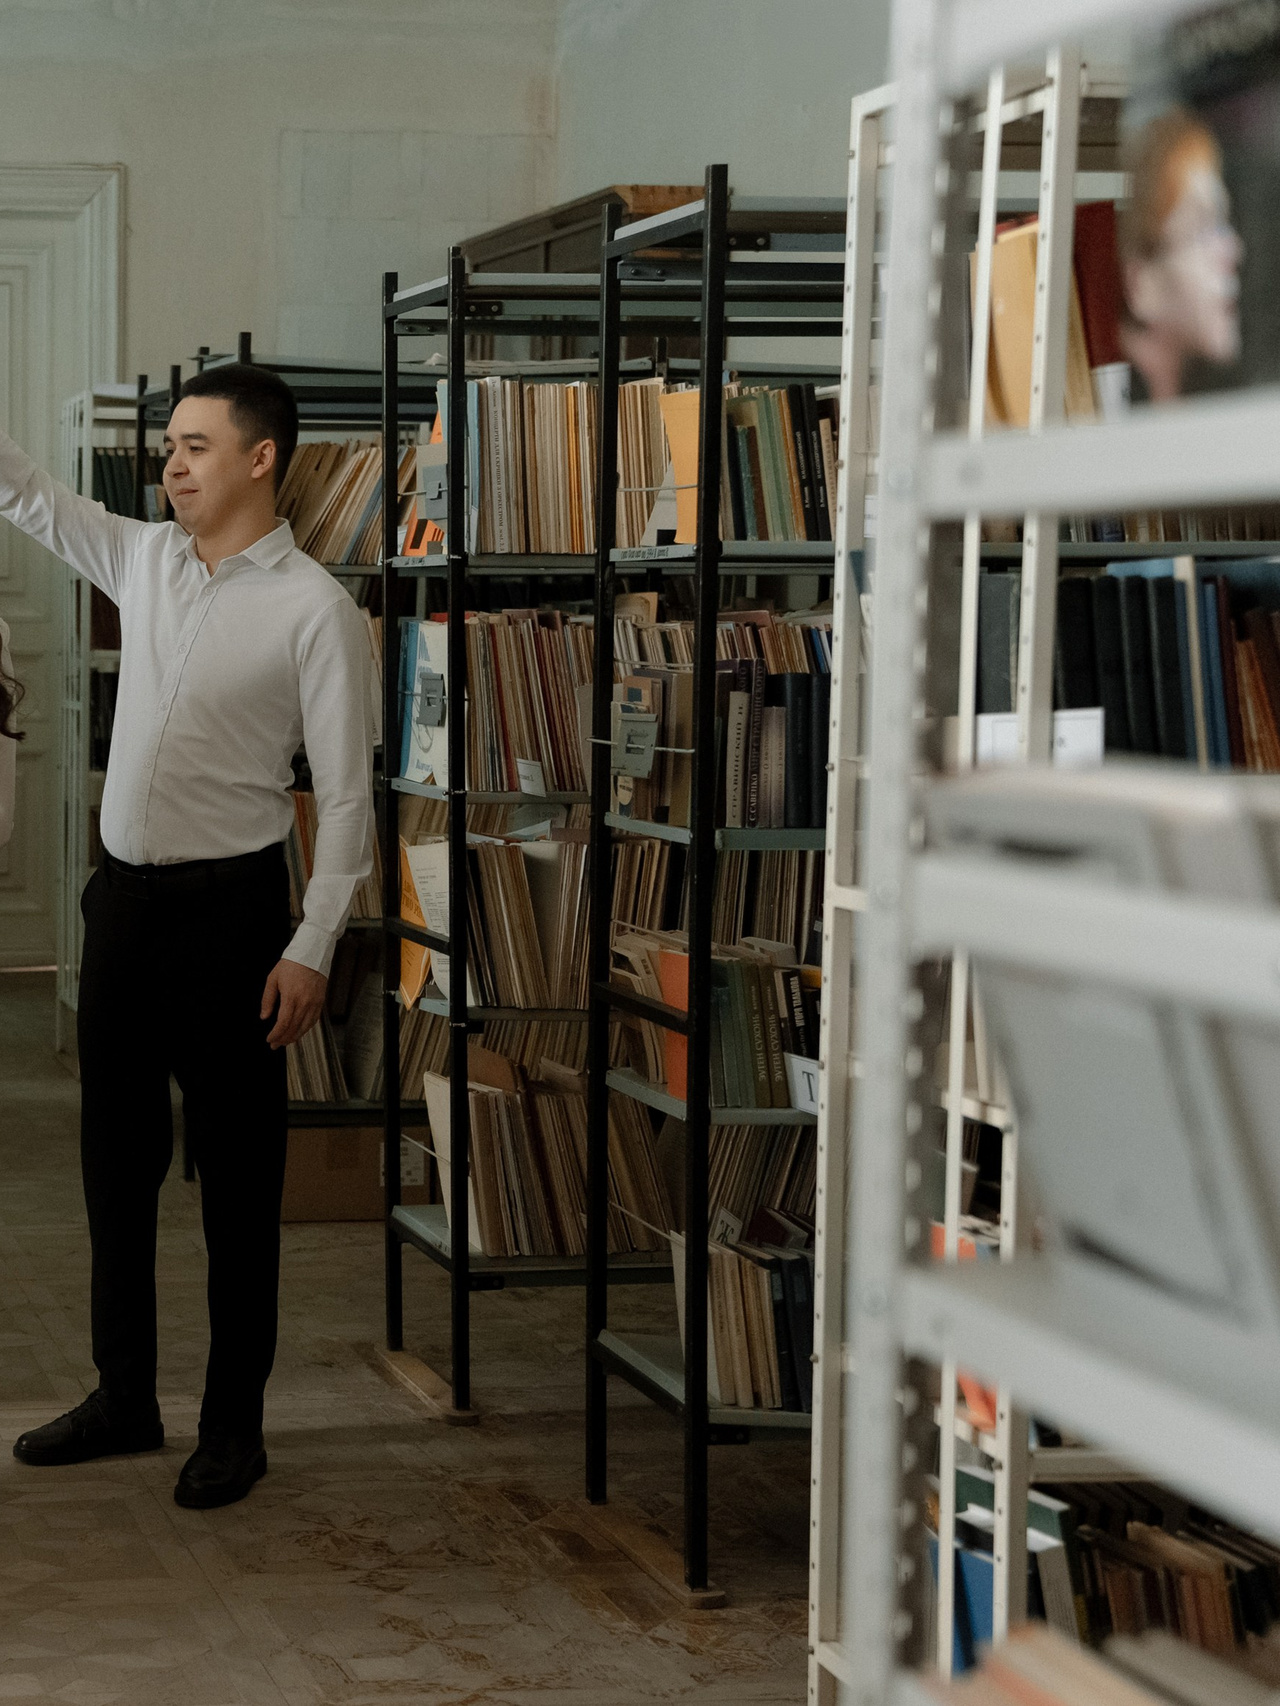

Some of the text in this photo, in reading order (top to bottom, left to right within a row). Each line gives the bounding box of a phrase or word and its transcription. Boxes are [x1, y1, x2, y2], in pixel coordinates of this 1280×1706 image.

[752, 665, 763, 747] СТРАВИНСКОГО
[731, 722, 742, 819] СТРАВИНСКИЙ
[748, 773, 758, 822] С.САВЕНКО
[790, 976, 802, 1007] ТАЛЬКОВА
[794, 1007, 805, 1027] ИГОРЯ
